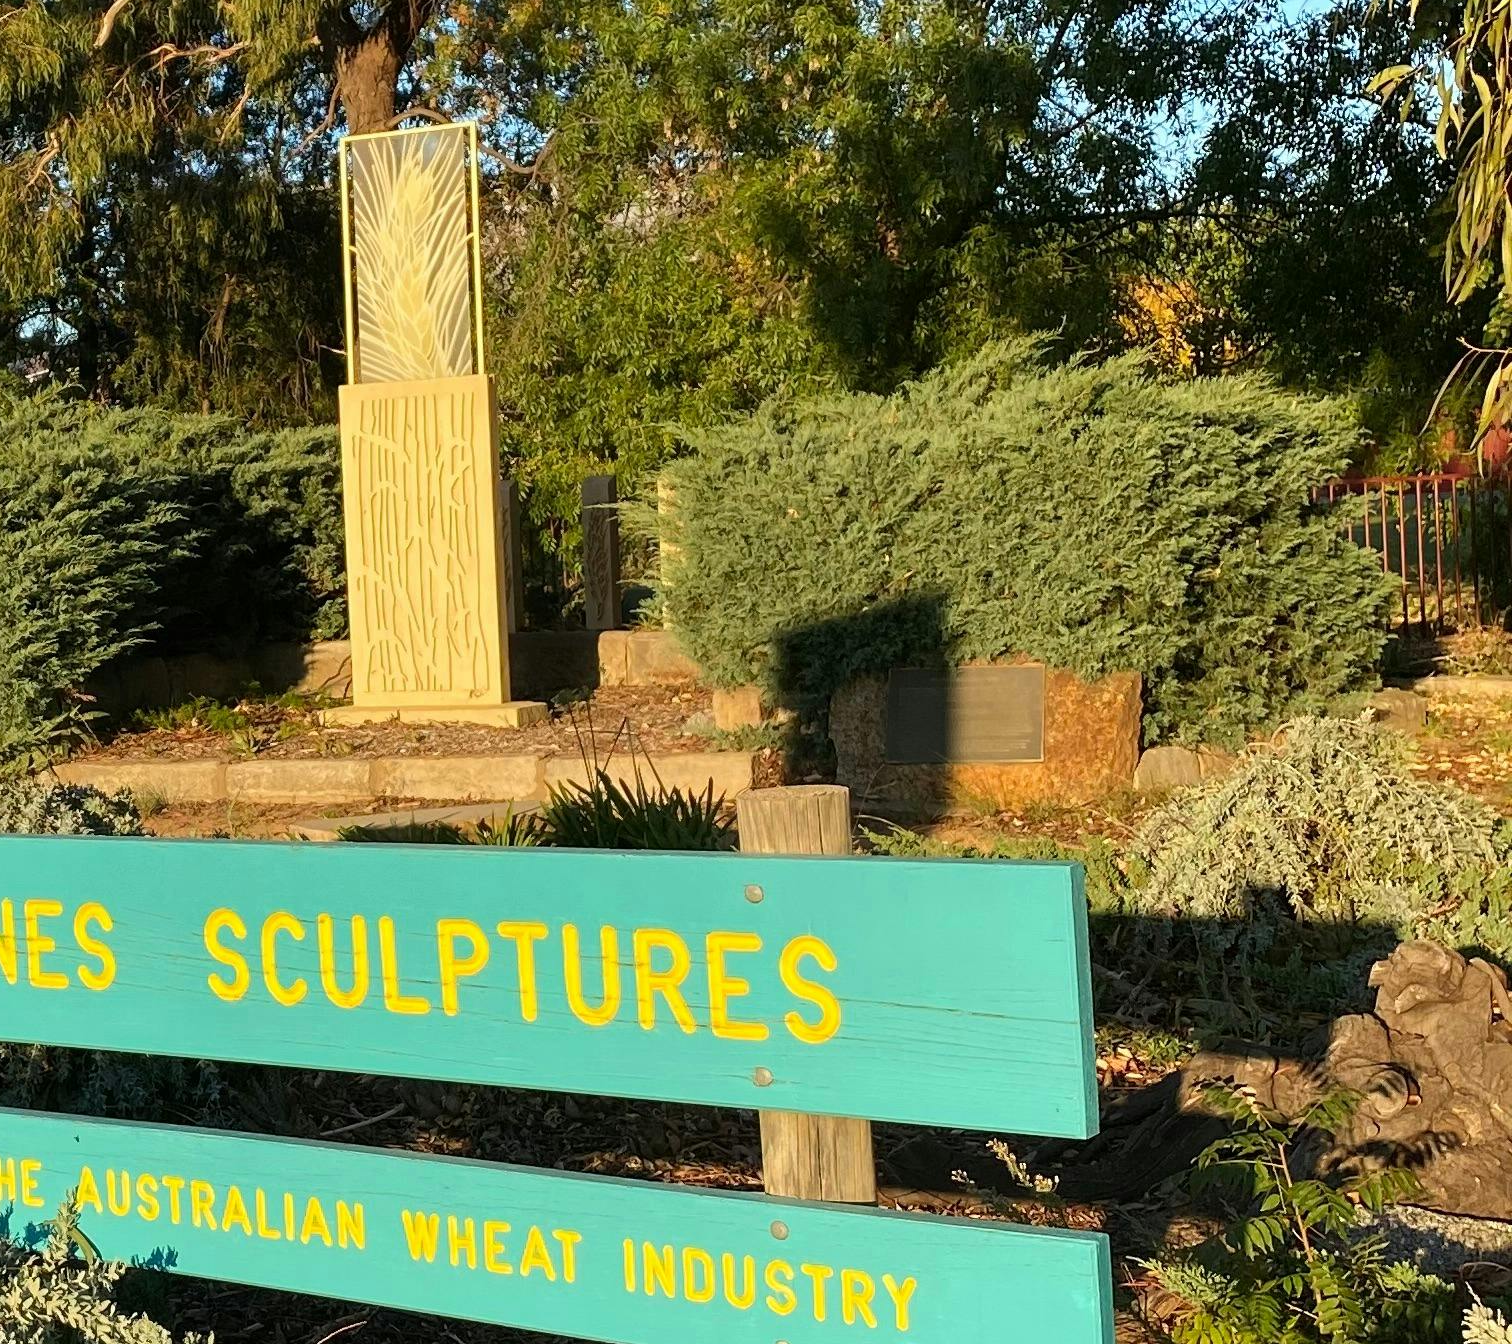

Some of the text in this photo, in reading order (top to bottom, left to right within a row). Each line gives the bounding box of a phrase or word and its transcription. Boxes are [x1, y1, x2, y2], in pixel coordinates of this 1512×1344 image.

[202, 906, 843, 1044] SCULPTURES
[74, 1165, 366, 1251] AUSTRALIAN
[400, 1208, 583, 1284] WHEAT
[622, 1238, 918, 1332] INDUSTRY
